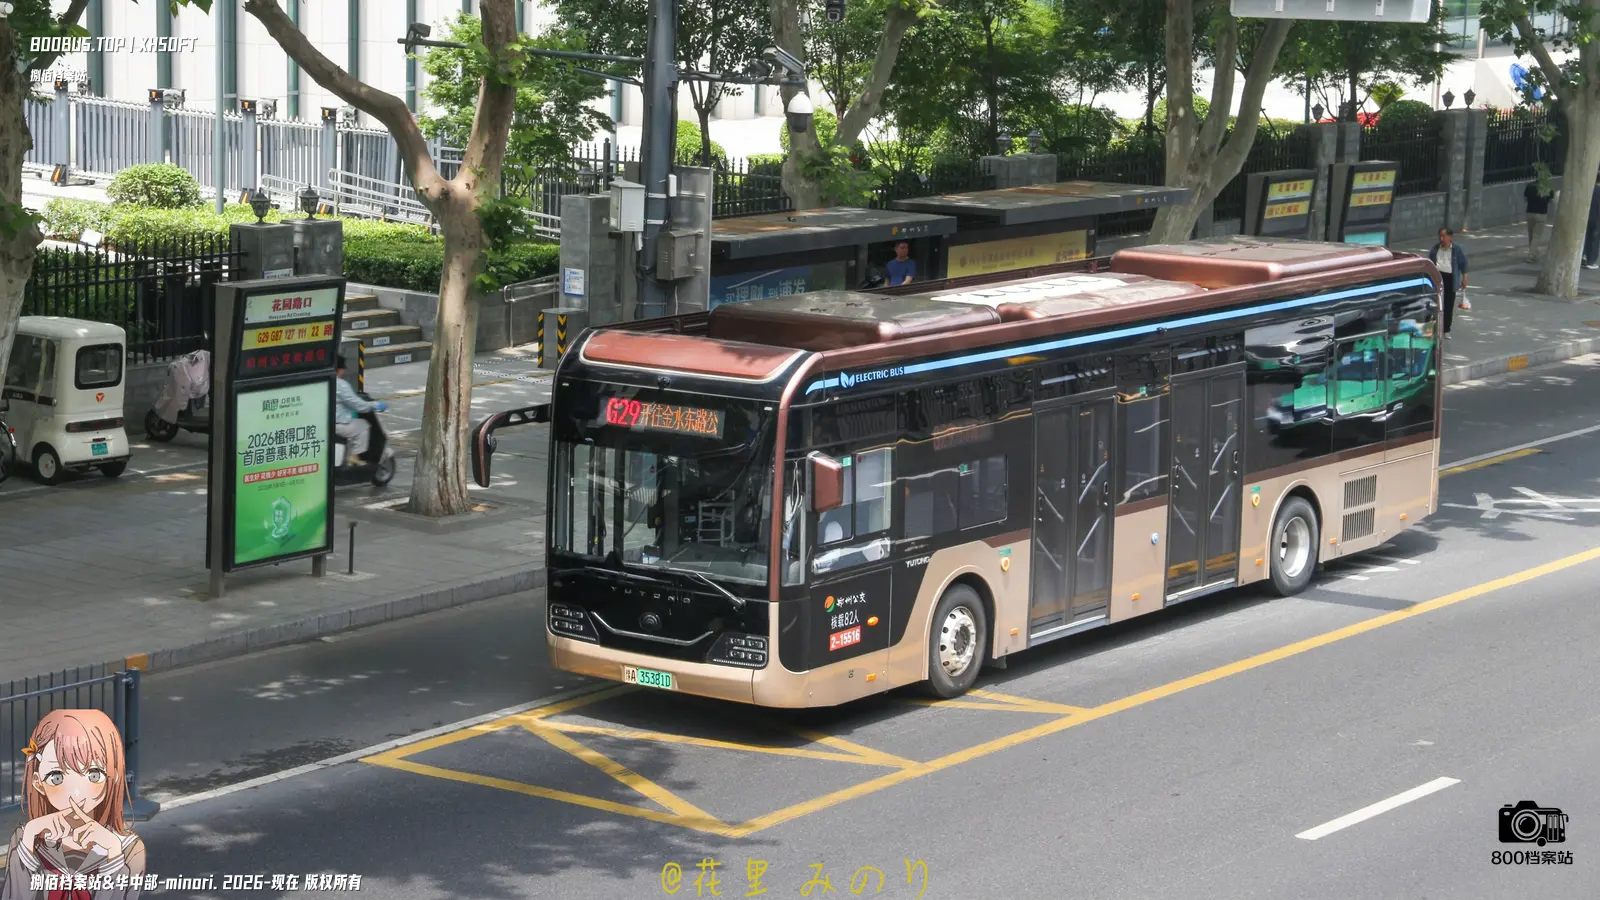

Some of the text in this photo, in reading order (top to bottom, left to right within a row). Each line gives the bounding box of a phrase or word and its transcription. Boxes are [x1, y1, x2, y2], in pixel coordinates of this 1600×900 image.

[271, 297, 312, 312] 花园路口
[311, 326, 320, 337] 22
[855, 366, 904, 383] ELECTRIC BUS
[606, 397, 718, 434] G29 开往金水东路公
[247, 425, 317, 449] 2026植得口腔
[240, 440, 323, 467] 首届普惠种牙节
[830, 609, 859, 630] 核载82人
[831, 629, 861, 649] 2-15516
